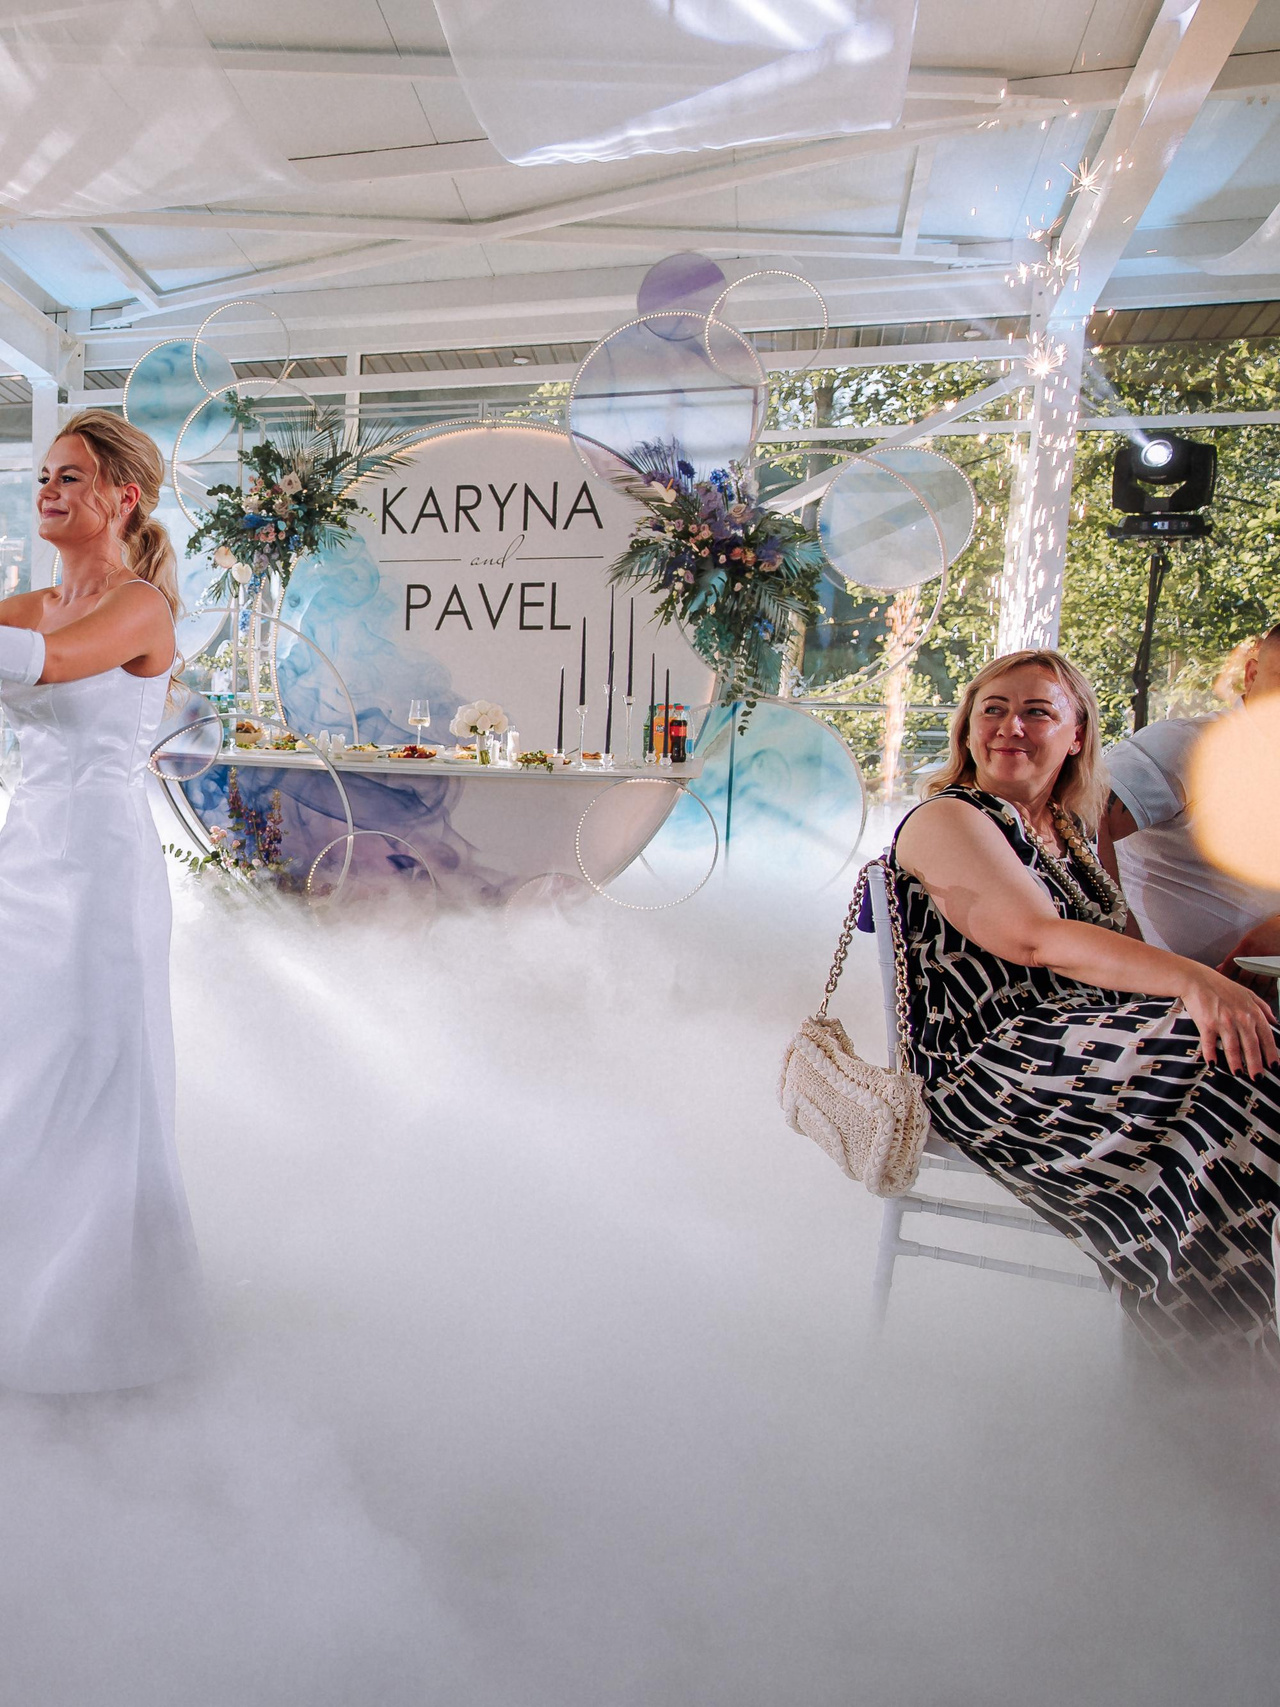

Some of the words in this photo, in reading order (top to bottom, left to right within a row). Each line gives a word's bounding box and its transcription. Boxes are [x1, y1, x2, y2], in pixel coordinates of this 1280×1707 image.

[381, 481, 603, 534] KARYNA
[470, 534, 525, 568] and
[405, 582, 571, 631] PAVEL
